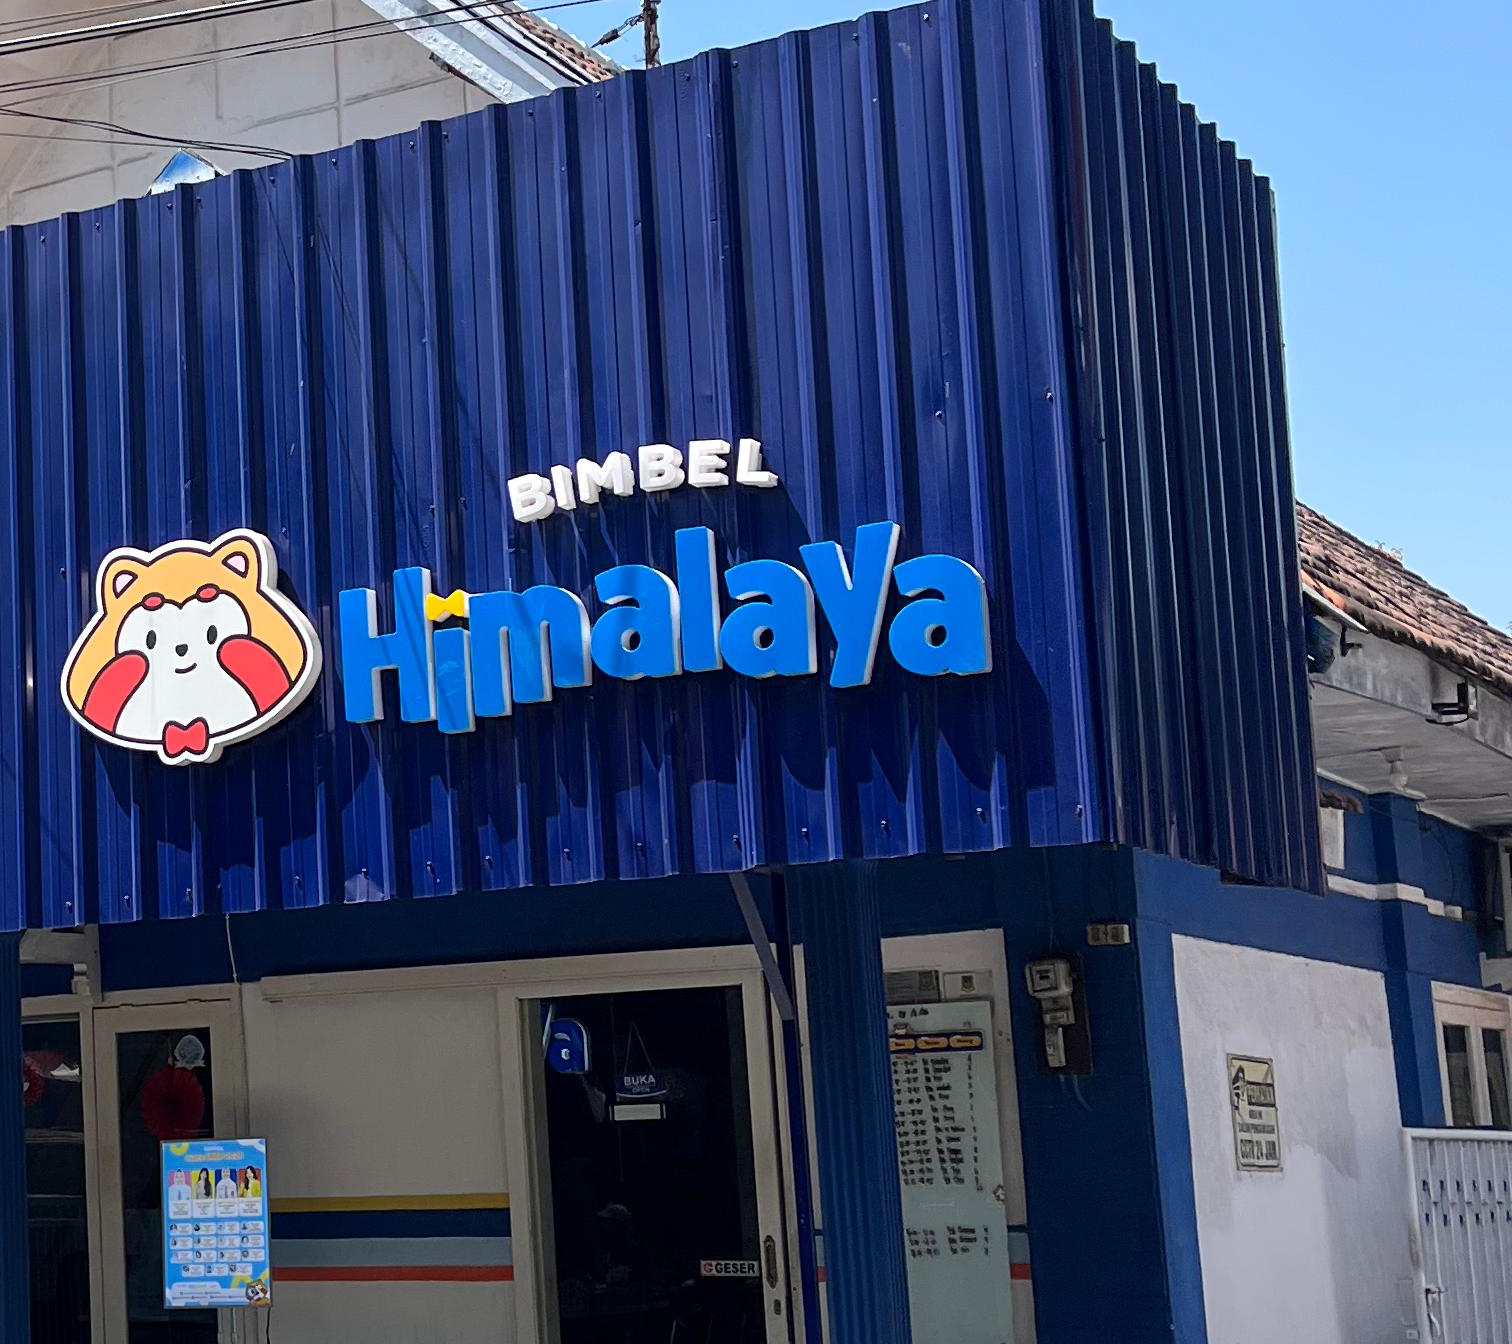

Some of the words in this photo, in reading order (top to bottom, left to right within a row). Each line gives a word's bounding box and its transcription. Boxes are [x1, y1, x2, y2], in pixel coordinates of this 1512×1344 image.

[507, 437, 778, 523] BIMBEL
[338, 521, 991, 734] Himalaya
[715, 1262, 756, 1274] GESER
